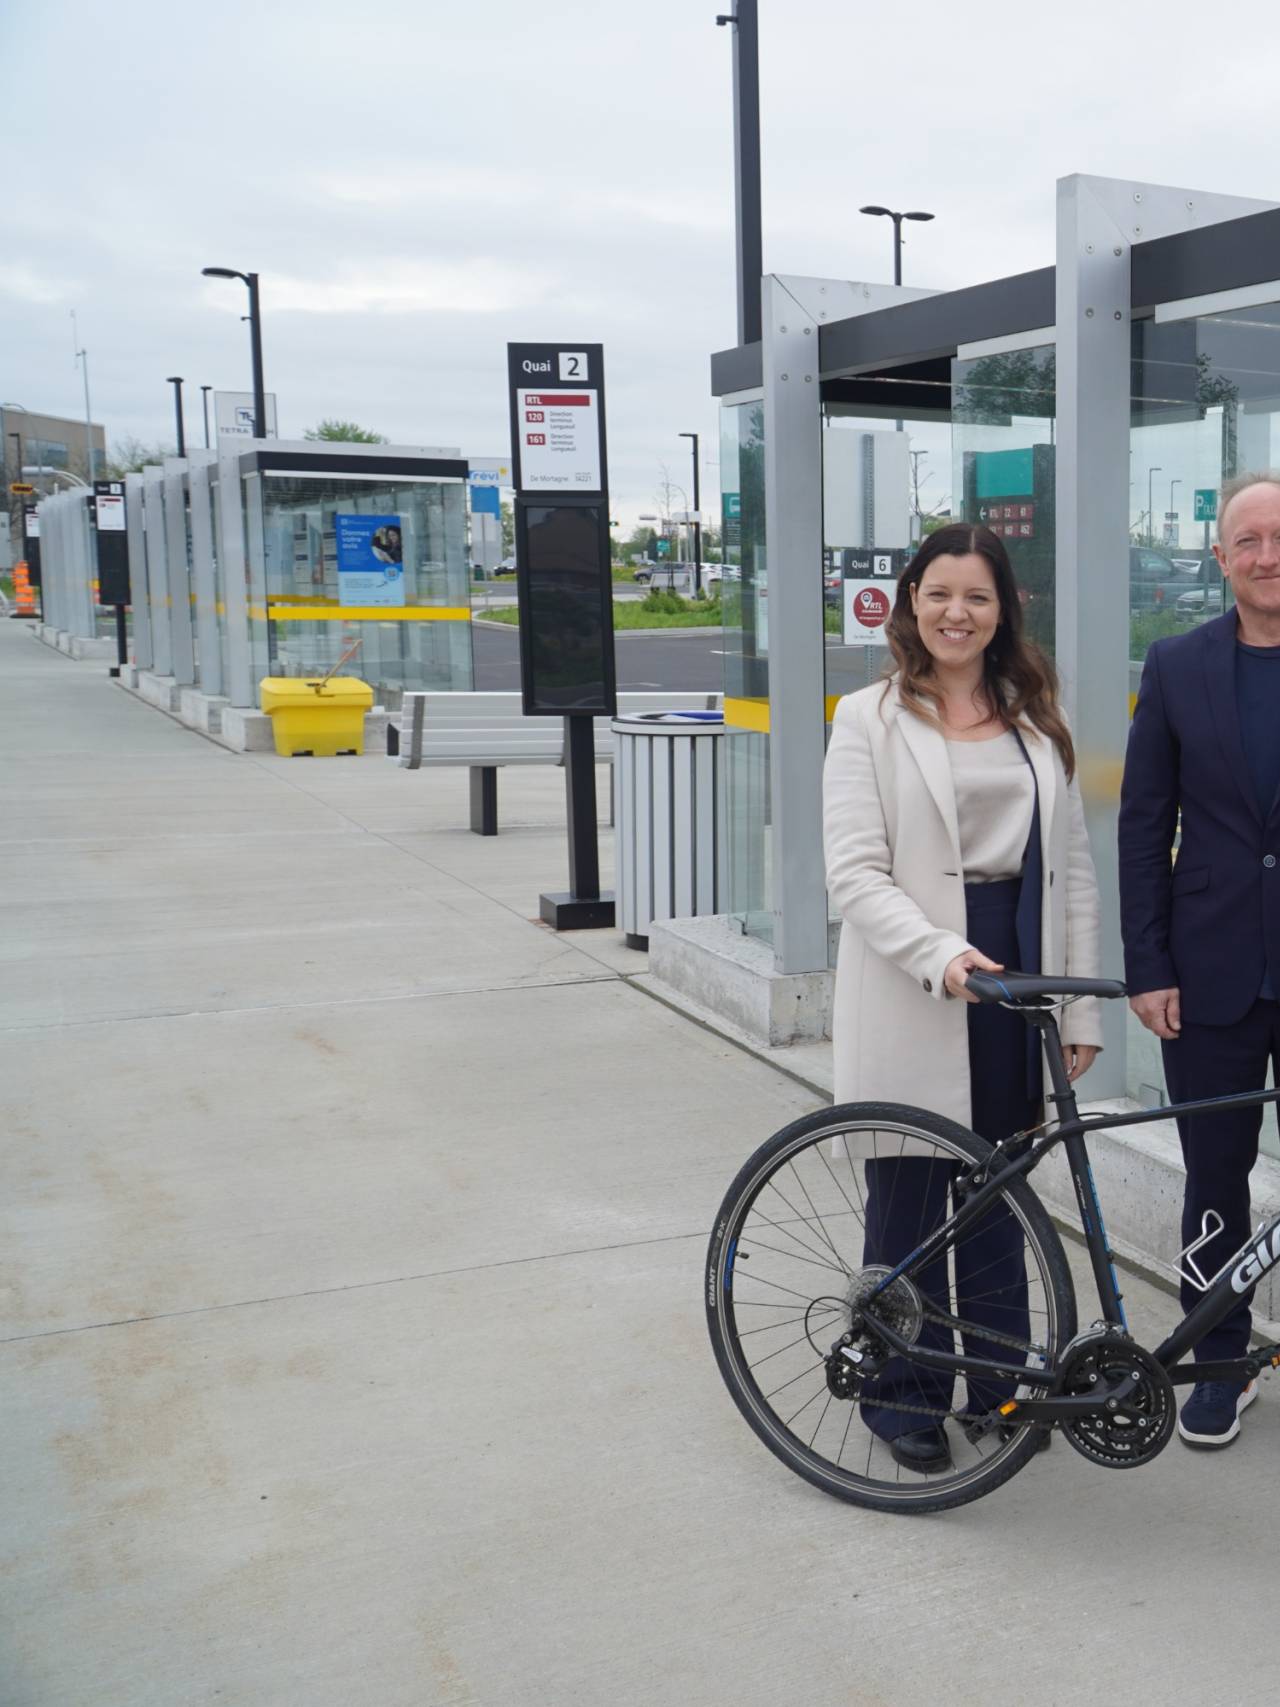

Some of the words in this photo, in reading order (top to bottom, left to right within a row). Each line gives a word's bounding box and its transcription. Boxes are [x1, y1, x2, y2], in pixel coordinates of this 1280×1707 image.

[522, 360, 551, 373] Quai
[567, 356, 581, 377] 2
[526, 396, 543, 405] RTL
[528, 412, 543, 422] 120
[529, 435, 544, 444] 161
[852, 560, 869, 569] Quai
[879, 559, 887, 572] 6
[870, 602, 883, 610] RTL
[708, 1266, 717, 1307] GIANT
